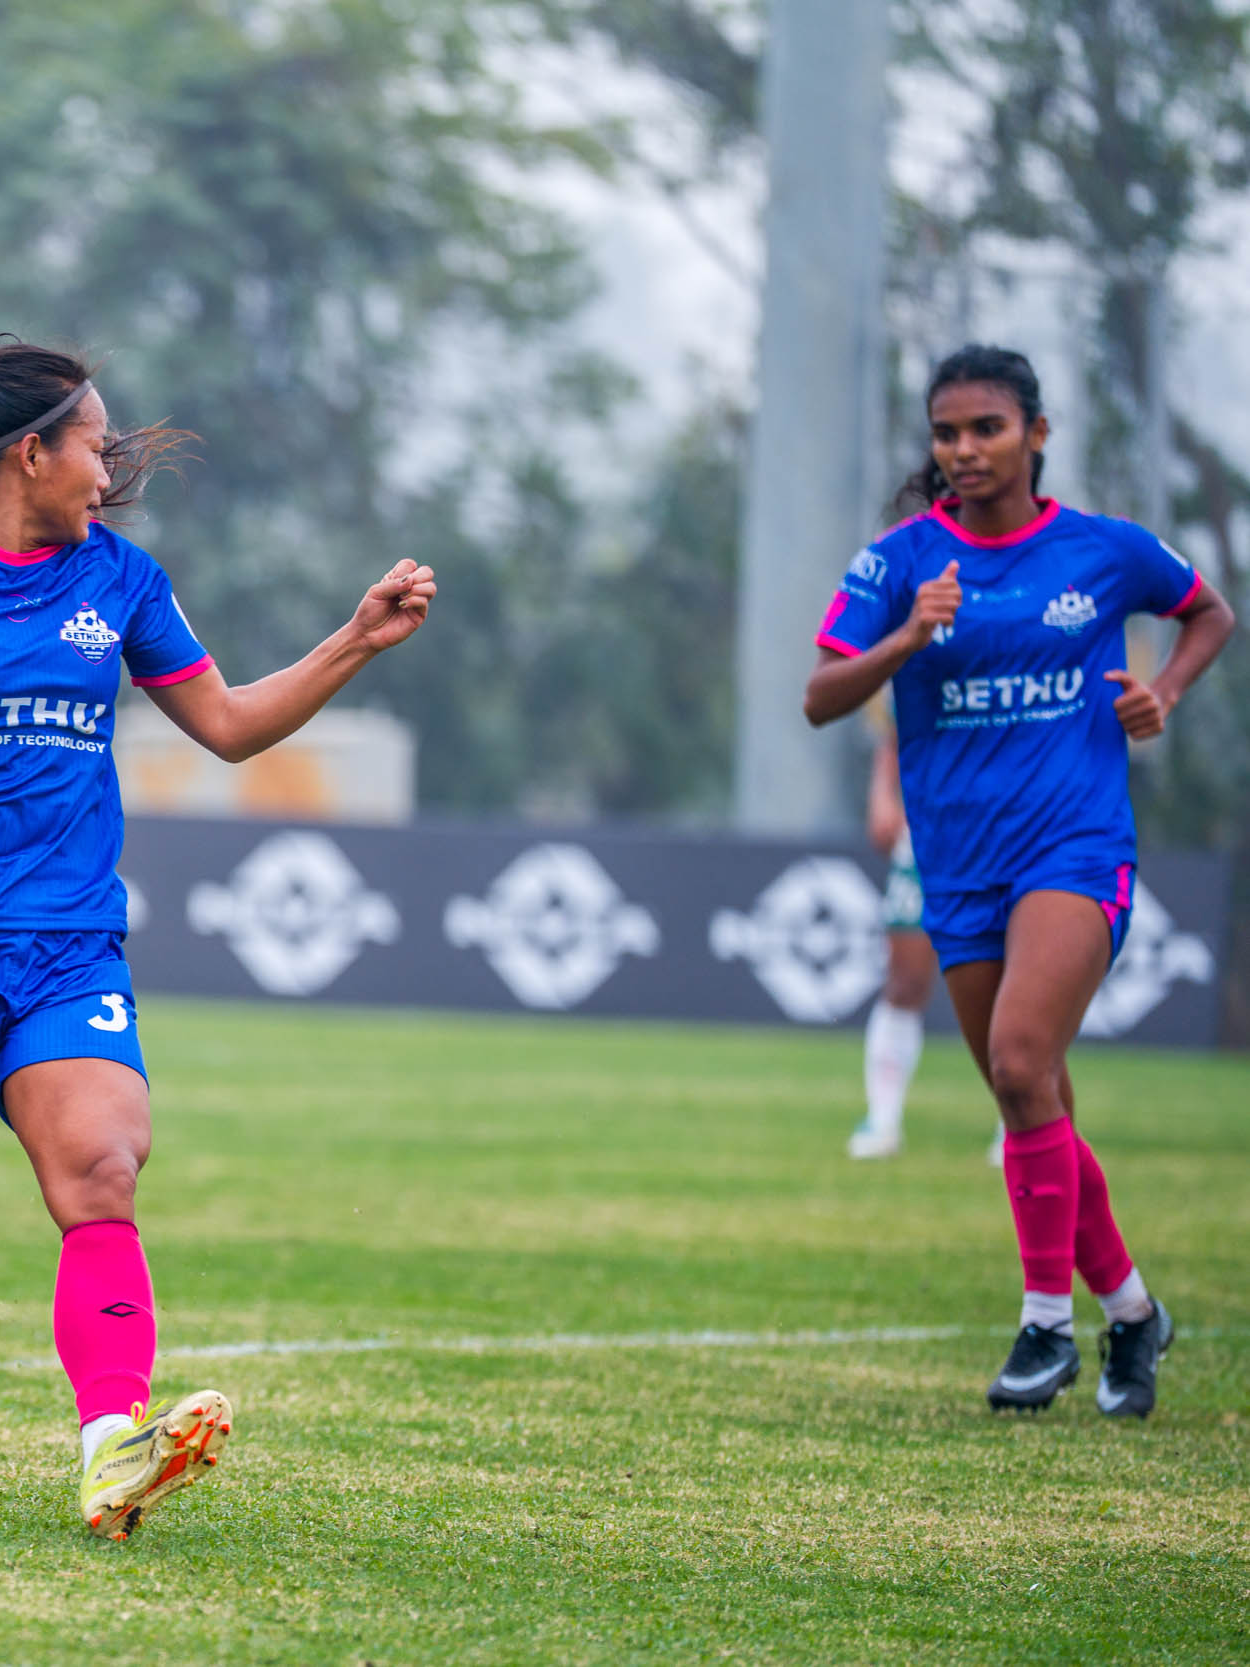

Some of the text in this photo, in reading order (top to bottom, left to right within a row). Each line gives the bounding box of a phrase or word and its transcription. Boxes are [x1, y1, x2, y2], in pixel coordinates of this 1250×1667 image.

[65, 631, 99, 642] SETHU
[942, 666, 1084, 713] SETHU
[16, 734, 106, 754] TECHNOLOGY
[87, 993, 129, 1033] 3
